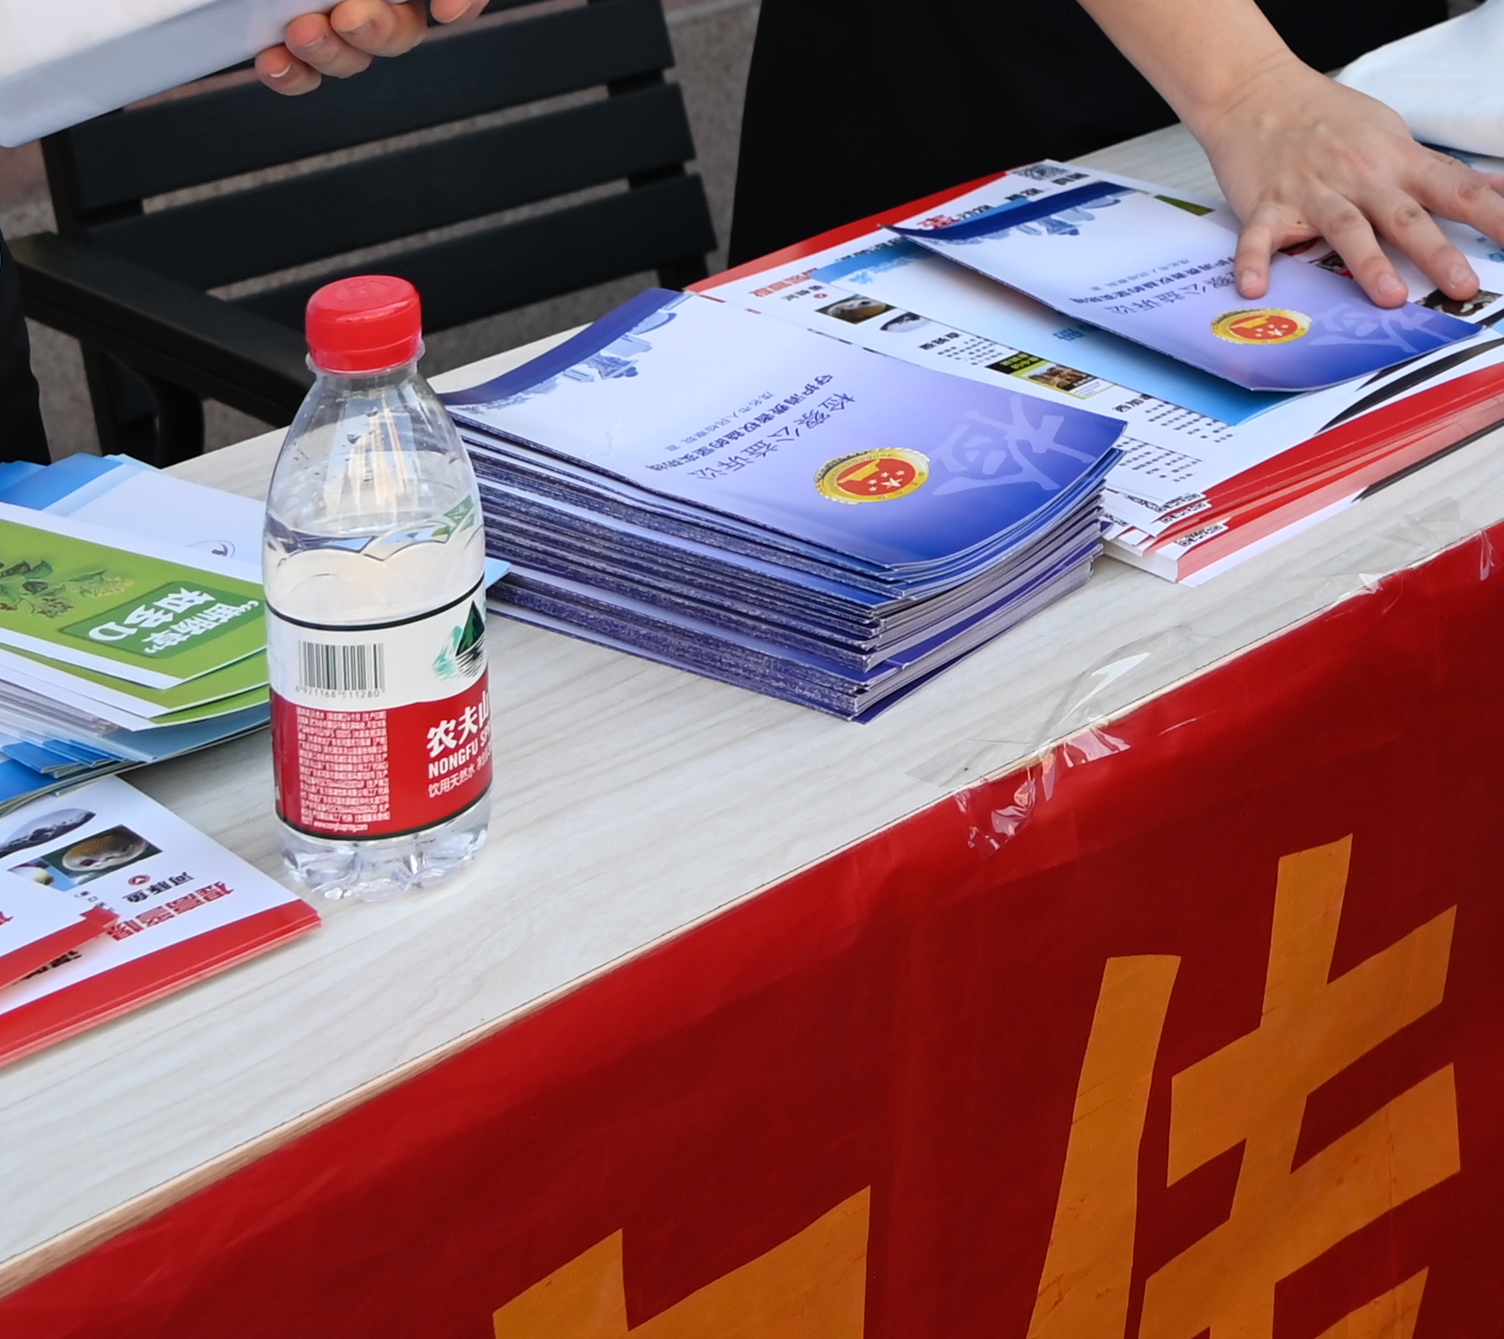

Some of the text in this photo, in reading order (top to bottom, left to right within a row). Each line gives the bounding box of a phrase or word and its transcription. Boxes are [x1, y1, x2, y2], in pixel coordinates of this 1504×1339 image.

[1105, 270, 1239, 321] 察公益诉讼
[687, 391, 855, 479] 检察公益诉讼
[425, 689, 492, 759] 农夫山
[427, 737, 479, 780] NONGFU
